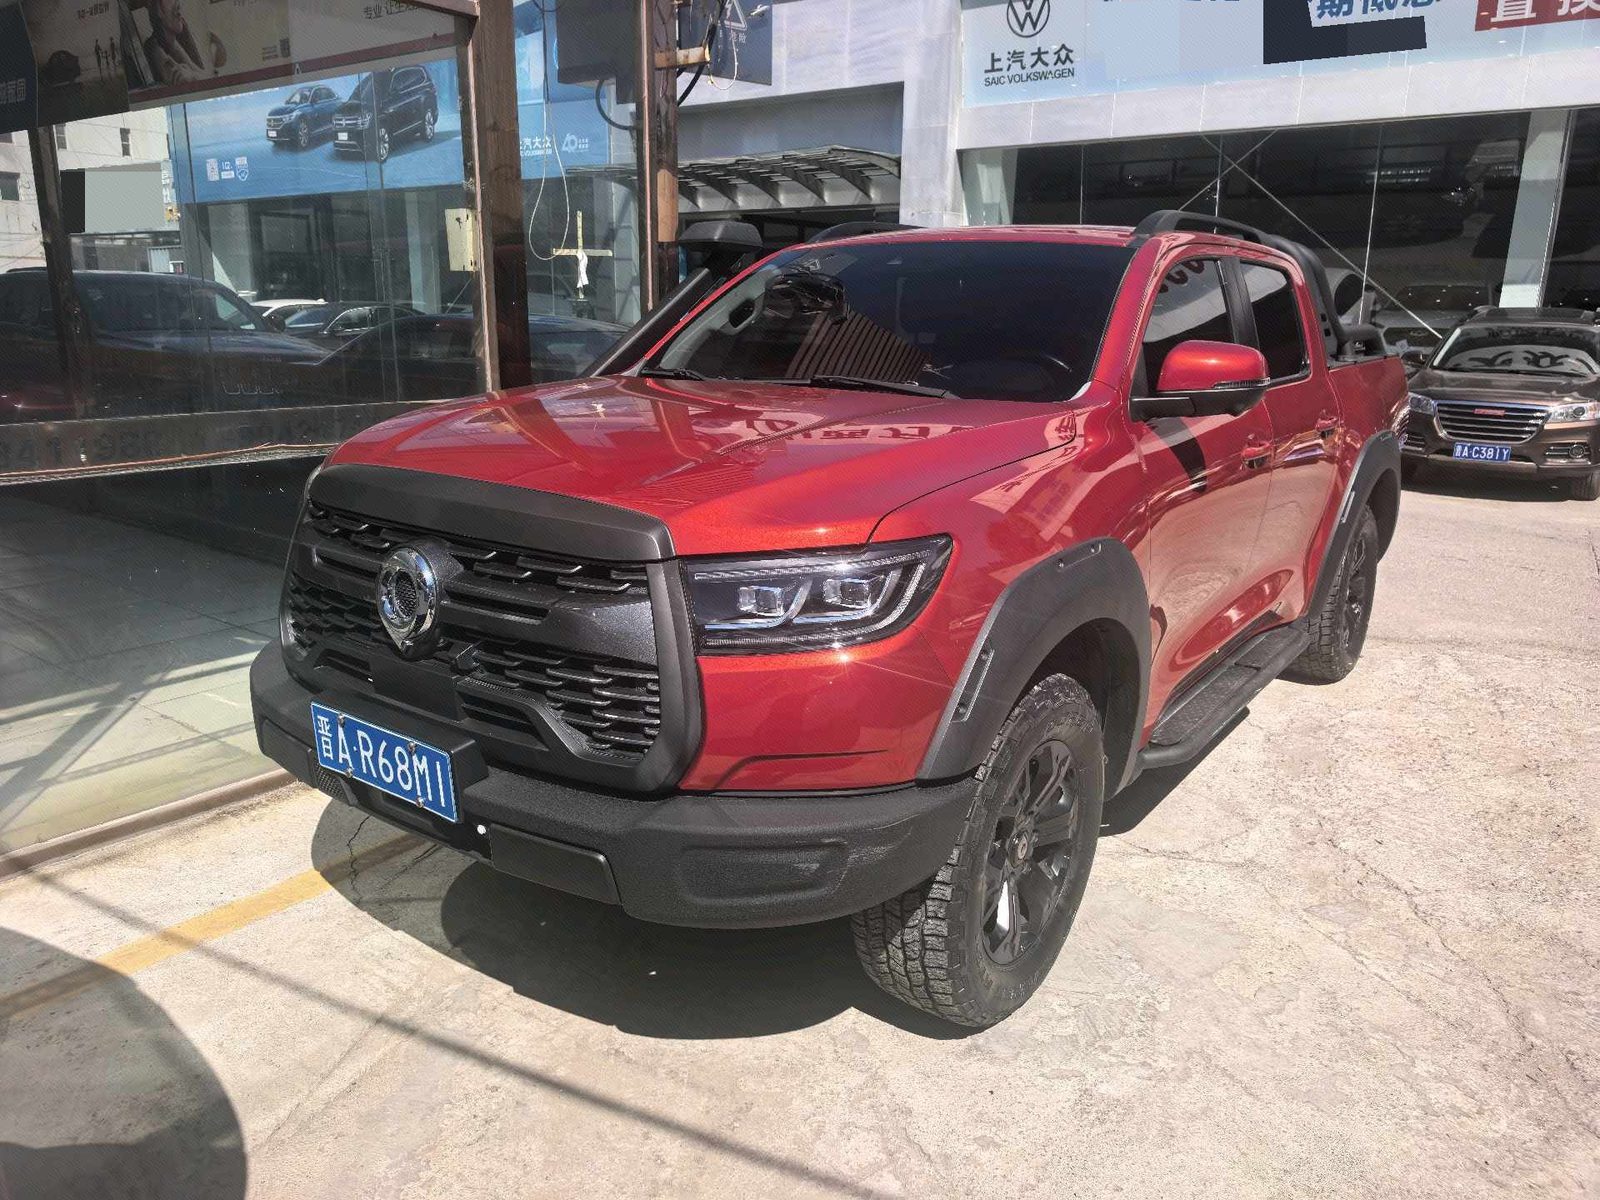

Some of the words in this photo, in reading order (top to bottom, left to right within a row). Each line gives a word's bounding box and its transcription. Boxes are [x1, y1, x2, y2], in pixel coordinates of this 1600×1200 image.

[984, 43, 1074, 73] 上汽大众
[984, 75, 1006, 87] SAIC
[1006, 67, 1075, 84] VOLKSWAGEN
[317, 714, 446, 808] 晋A·R68M1
